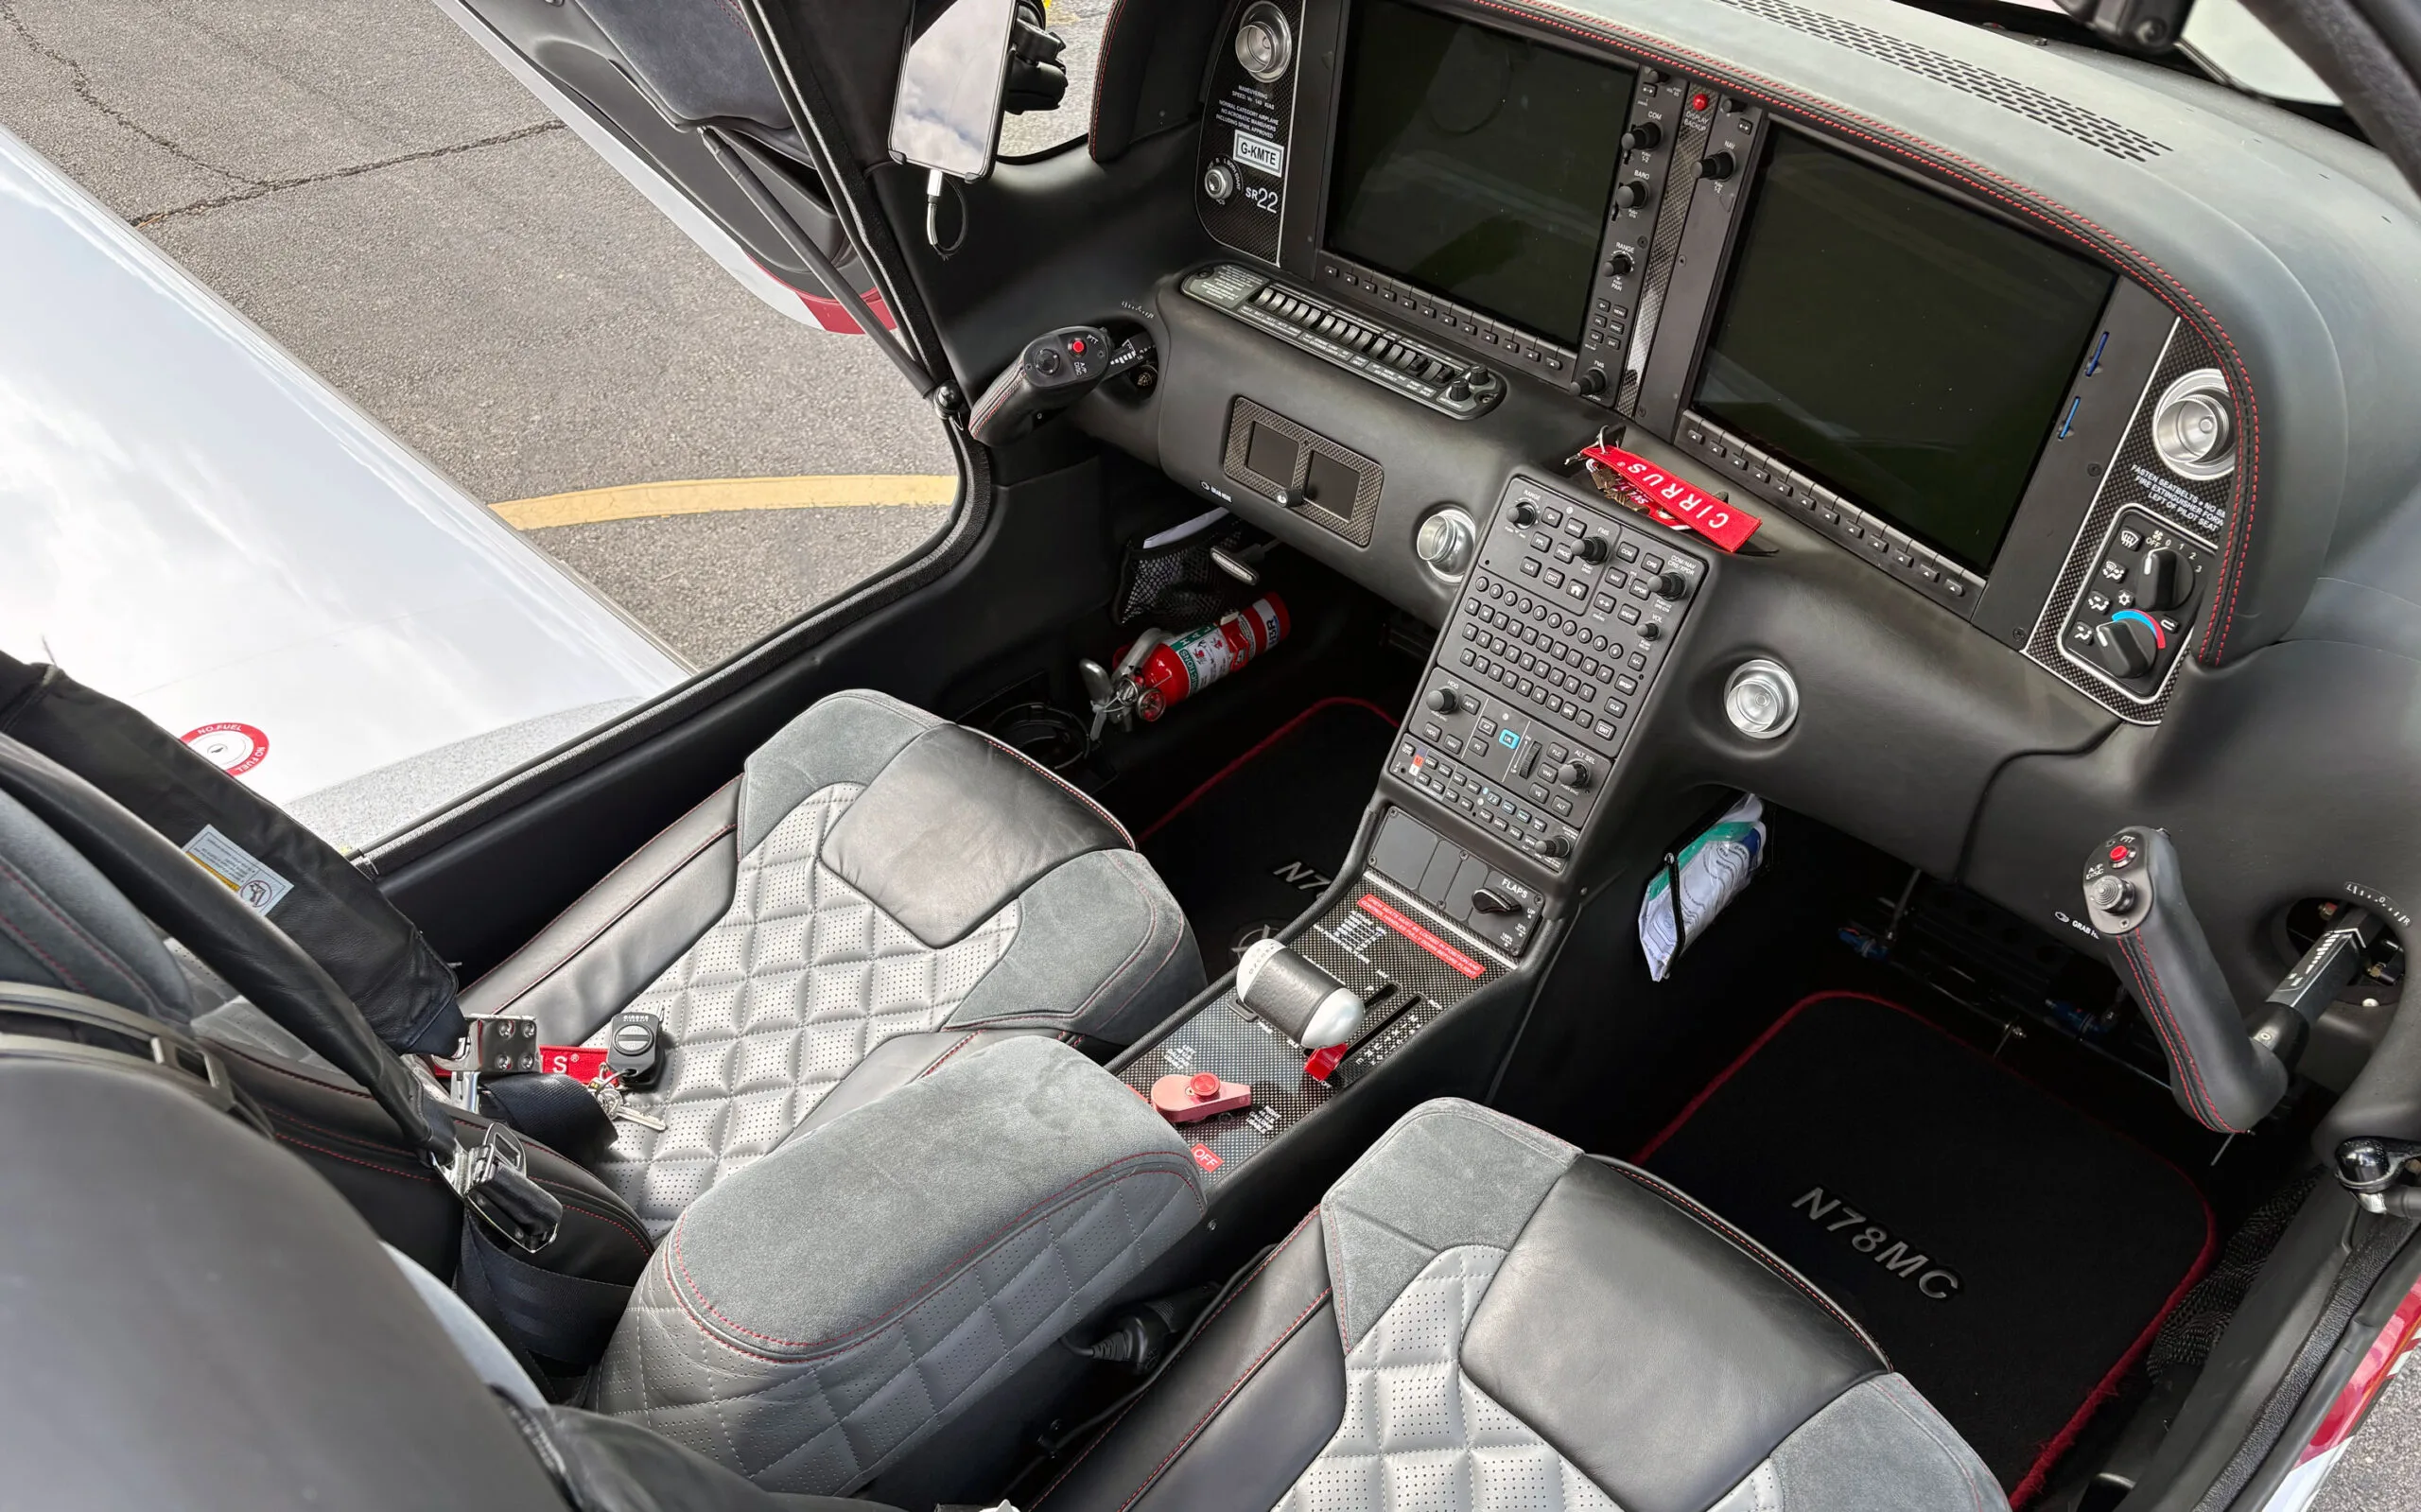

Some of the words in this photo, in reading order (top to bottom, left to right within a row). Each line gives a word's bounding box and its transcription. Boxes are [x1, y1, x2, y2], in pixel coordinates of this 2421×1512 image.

[1219, 99, 1236, 110] NORMAL
[1236, 103, 1259, 117] CATEGORY
[1259, 113, 1280, 125] AIRPLANE
[1647, 111, 1663, 121] COM
[1685, 111, 1709, 124] DISPLAY
[1215, 113, 1238, 126] INCLUDING
[1251, 126, 1274, 139] APPROVED
[1250, 118, 1277, 131] MANEUVERS
[1683, 117, 1707, 132] BACKUP
[1724, 141, 1736, 149] NAV
[1241, 142, 1276, 165] G-KMTE
[1633, 169, 1650, 180] BARO
[1245, 187, 1278, 214] SR22
[1616, 242, 1634, 253] RANGE
[1611, 283, 1623, 291] PAN
[1087, 334, 1099, 344] PTT
[2131, 464, 2159, 482] FASTEN
[2158, 478, 2199, 503] SEATBELTS
[2203, 502, 2217, 513] NO
[1524, 489, 1541, 501] RANGE
[2134, 475, 2152, 489] FIRE
[2151, 483, 2203, 515] EXTINGUISHER
[2148, 492, 2168, 505] LEFT
[2166, 501, 2177, 510] OF
[2176, 506, 2199, 521] PILOT
[2197, 517, 2219, 531] SEAT
[1568, 523, 1581, 532] MENU
[1598, 527, 1610, 536] FMS
[1557, 548, 1571, 558] PROC
[1620, 548, 1633, 557] COM
[2145, 536, 2161, 549] OFF
[2165, 539, 2172, 547] 0
[2188, 552, 2197, 561] 2
[1547, 574, 1558, 582] ENT
[1633, 585, 1647, 595] XPDR
[1621, 610, 1636, 620] IDENT
[1652, 614, 1663, 622] VOL
[1447, 679, 1459, 689] HDG
[198, 725, 214, 735] NO
[216, 723, 242, 732] FUEL
[1426, 728, 1437, 737] HDG
[1599, 726, 1609, 735] ENT
[255, 746, 266, 757] NO
[237, 755, 260, 773] FUEL
[1585, 756, 1595, 765] SEL
[2120, 835, 2135, 843] PTT
[2085, 868, 2104, 880] DISC
[1502, 878, 1528, 899] FLAPS
[2072, 920, 2092, 934] GRAB
[2403, 917, 2411, 926] R
[1360, 899, 1383, 916] CONTROL
[1420, 938, 1437, 951] DOWN
[1436, 948, 1457, 965] BEFORE
[1456, 962, 1475, 976] FLIGHT
[1382, 906, 1399, 918] SEATS
[1398, 916, 1412, 928] MUST
[1419, 930, 1438, 945] LOCKED
[1444, 946, 1469, 964] POSITION
[1467, 961, 1479, 971] AND
[1193, 1148, 1218, 1167] OFF
[1791, 1187, 1959, 1299] N78MC
